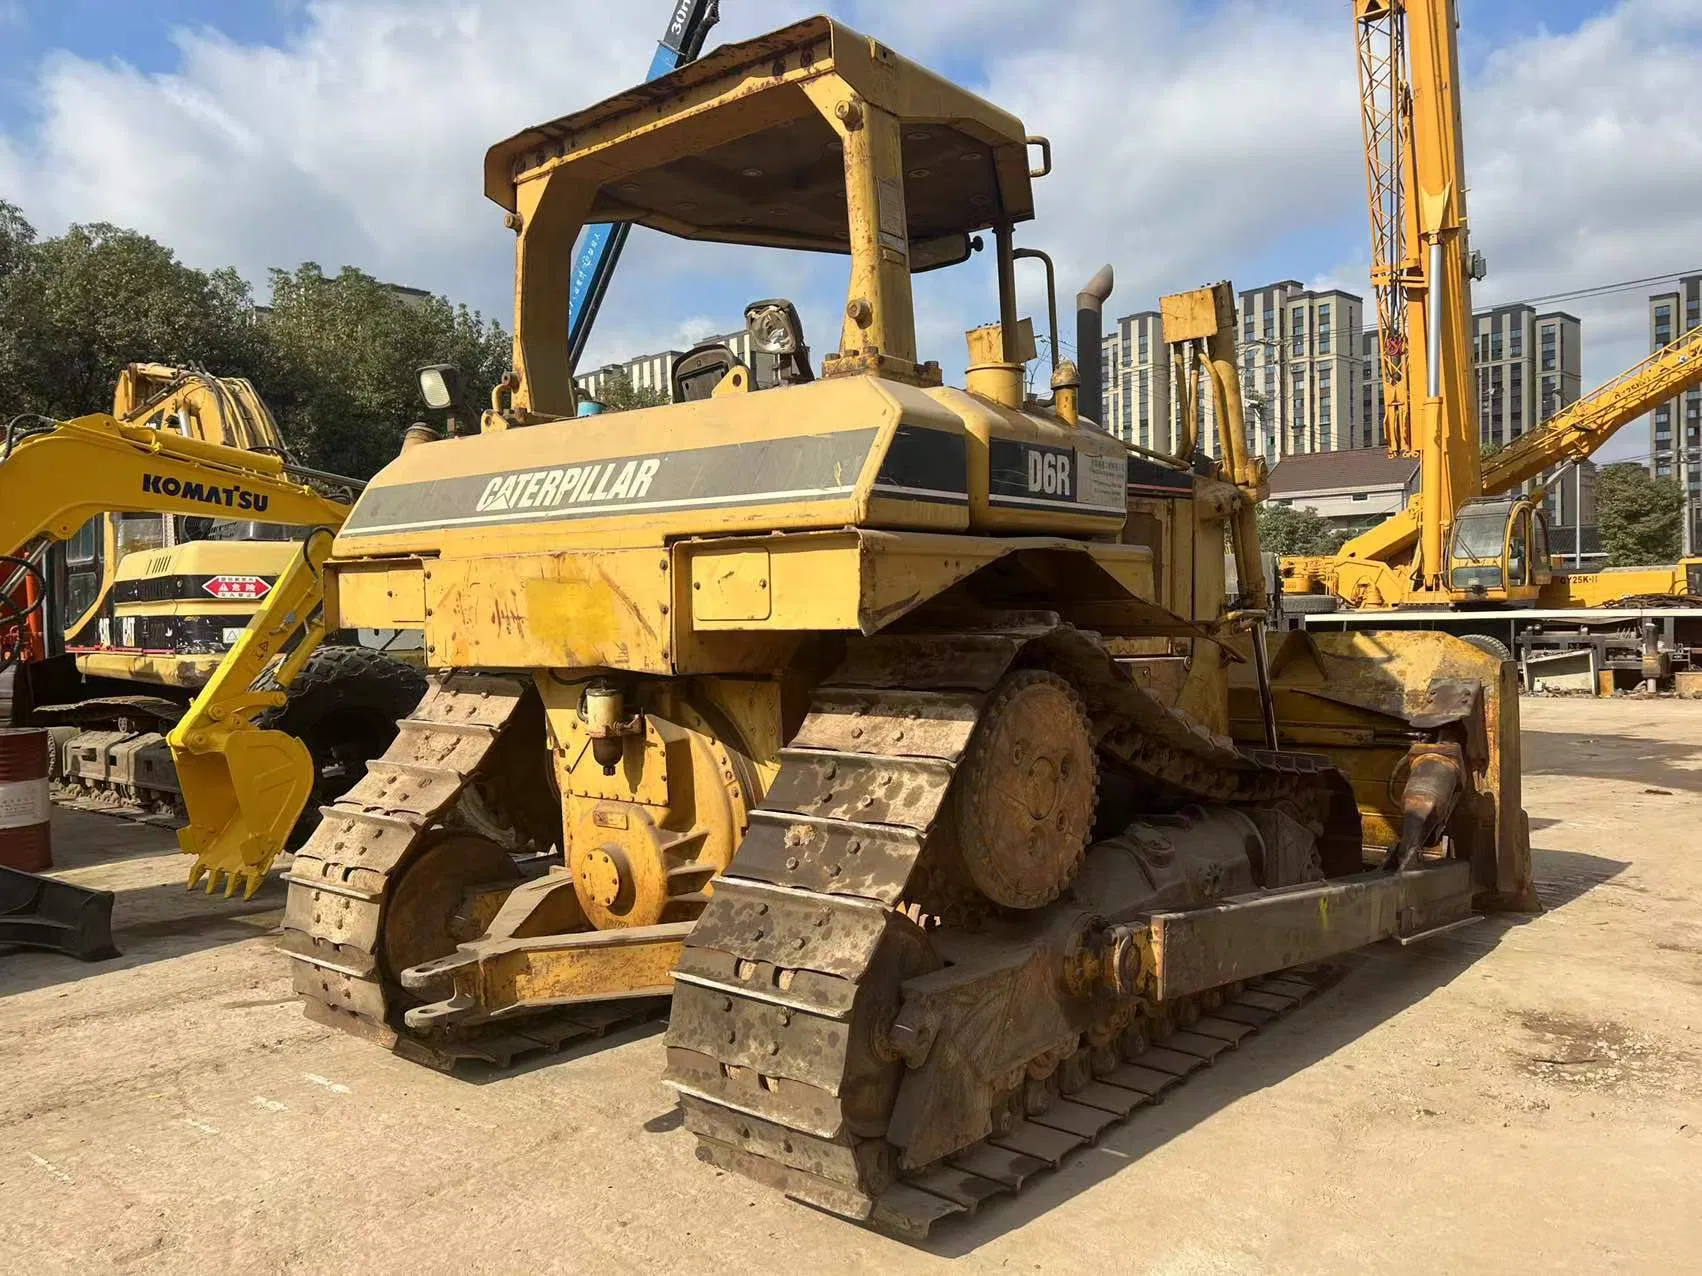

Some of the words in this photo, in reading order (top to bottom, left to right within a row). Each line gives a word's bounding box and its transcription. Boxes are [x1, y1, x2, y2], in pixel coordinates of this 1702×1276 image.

[142, 473, 268, 512] KOMATSU
[476, 459, 661, 511] CATERPILLAR
[1028, 447, 1070, 495] D6R
[122, 617, 135, 646] CAT
